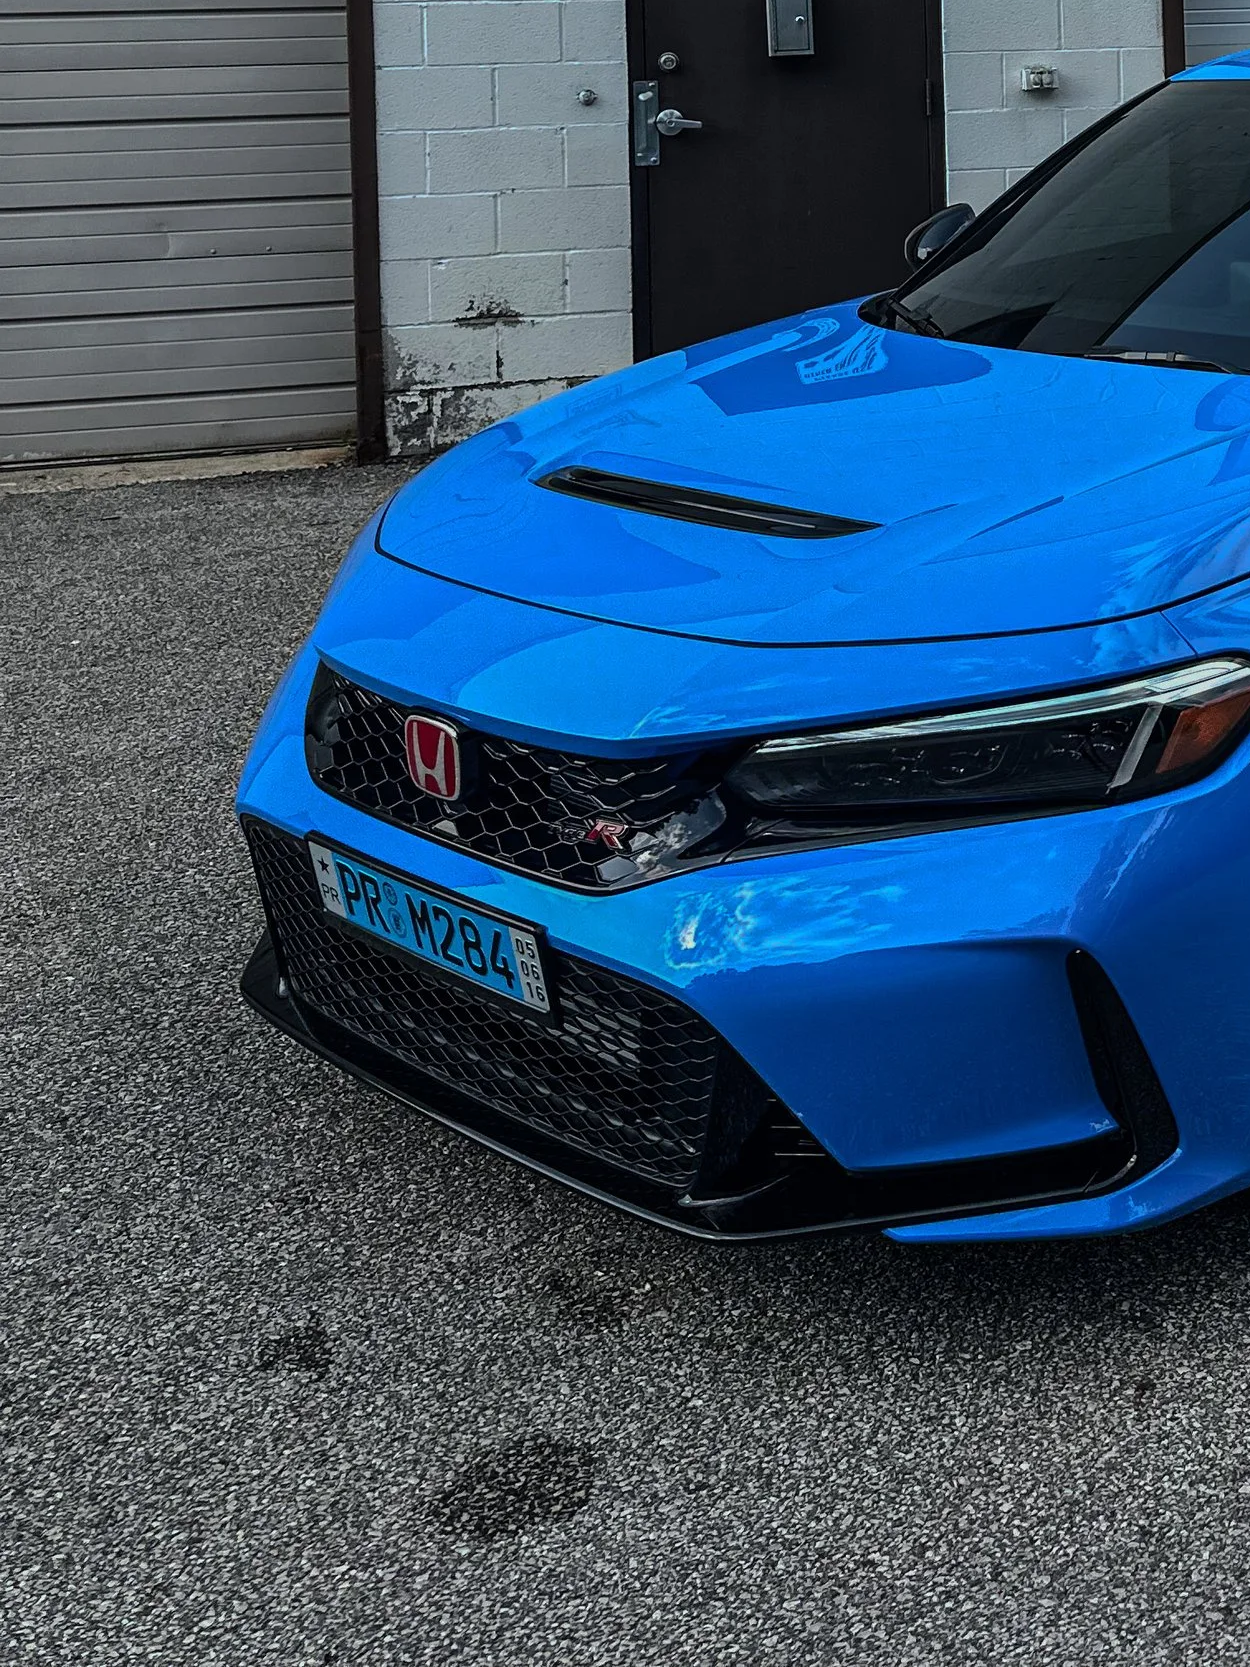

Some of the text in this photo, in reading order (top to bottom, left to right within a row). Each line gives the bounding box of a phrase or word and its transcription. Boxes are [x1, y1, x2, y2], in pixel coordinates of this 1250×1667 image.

[323, 885, 341, 905] PR
[336, 860, 514, 989] PR M284
[515, 938, 536, 958] 05
[520, 959, 540, 979] 06
[526, 982, 546, 1003] 16
